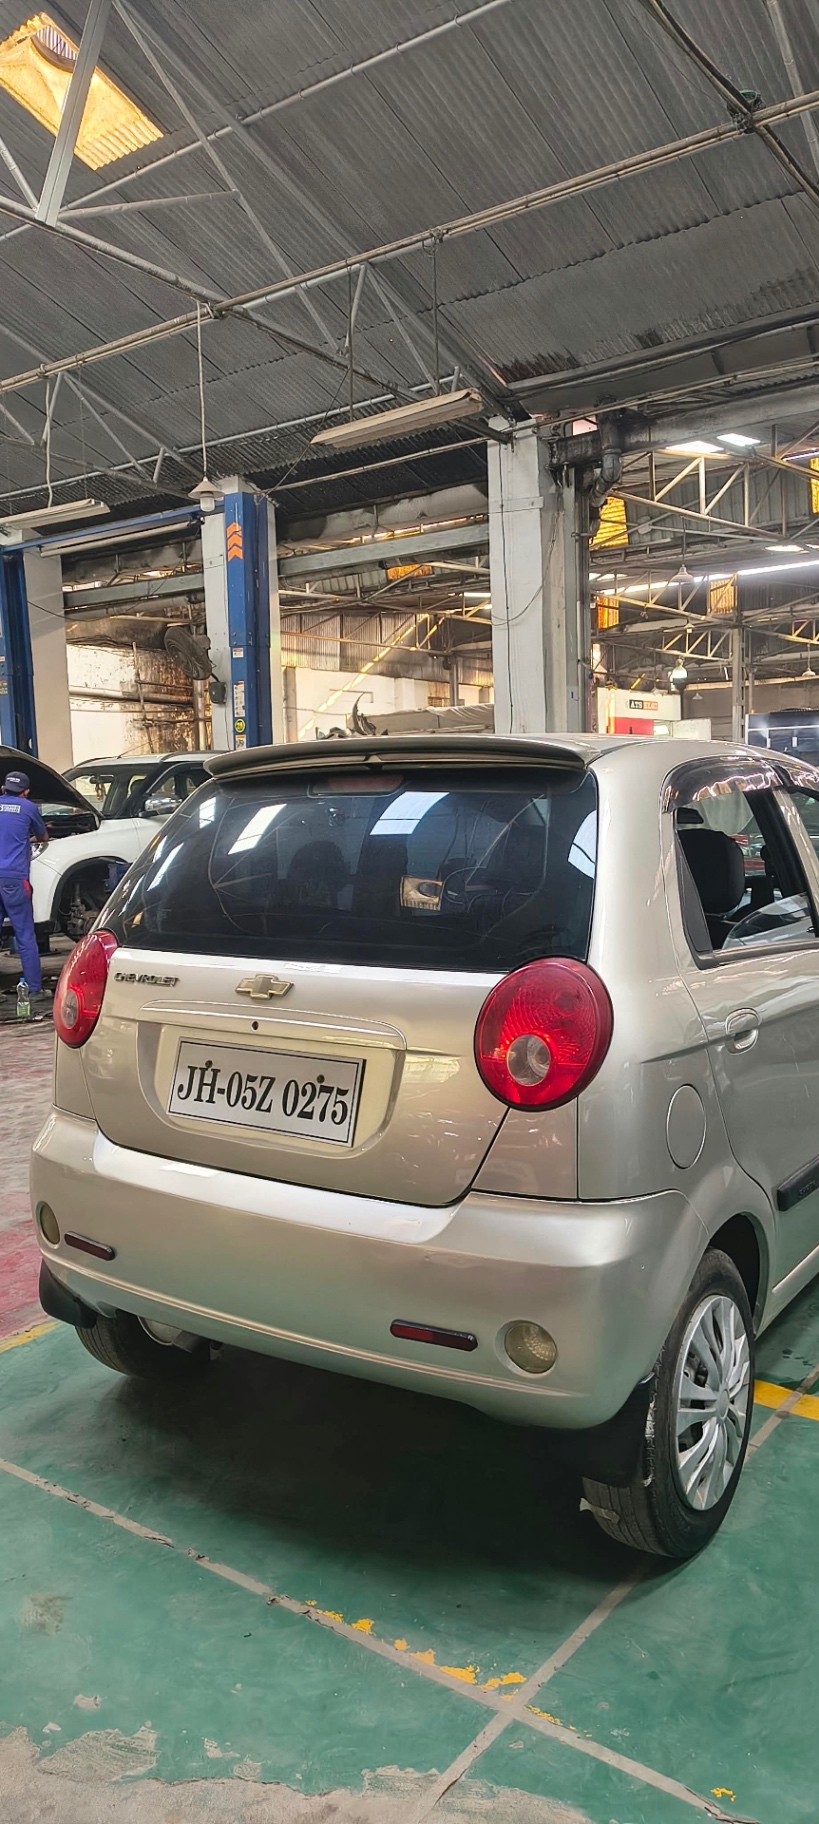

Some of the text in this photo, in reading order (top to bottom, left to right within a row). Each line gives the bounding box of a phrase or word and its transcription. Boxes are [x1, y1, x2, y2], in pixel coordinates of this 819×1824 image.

[630, 700, 643, 709] ATS
[114, 972, 180, 987] CHEVROLET
[177, 1064, 349, 1125] JH-05Z 0275
